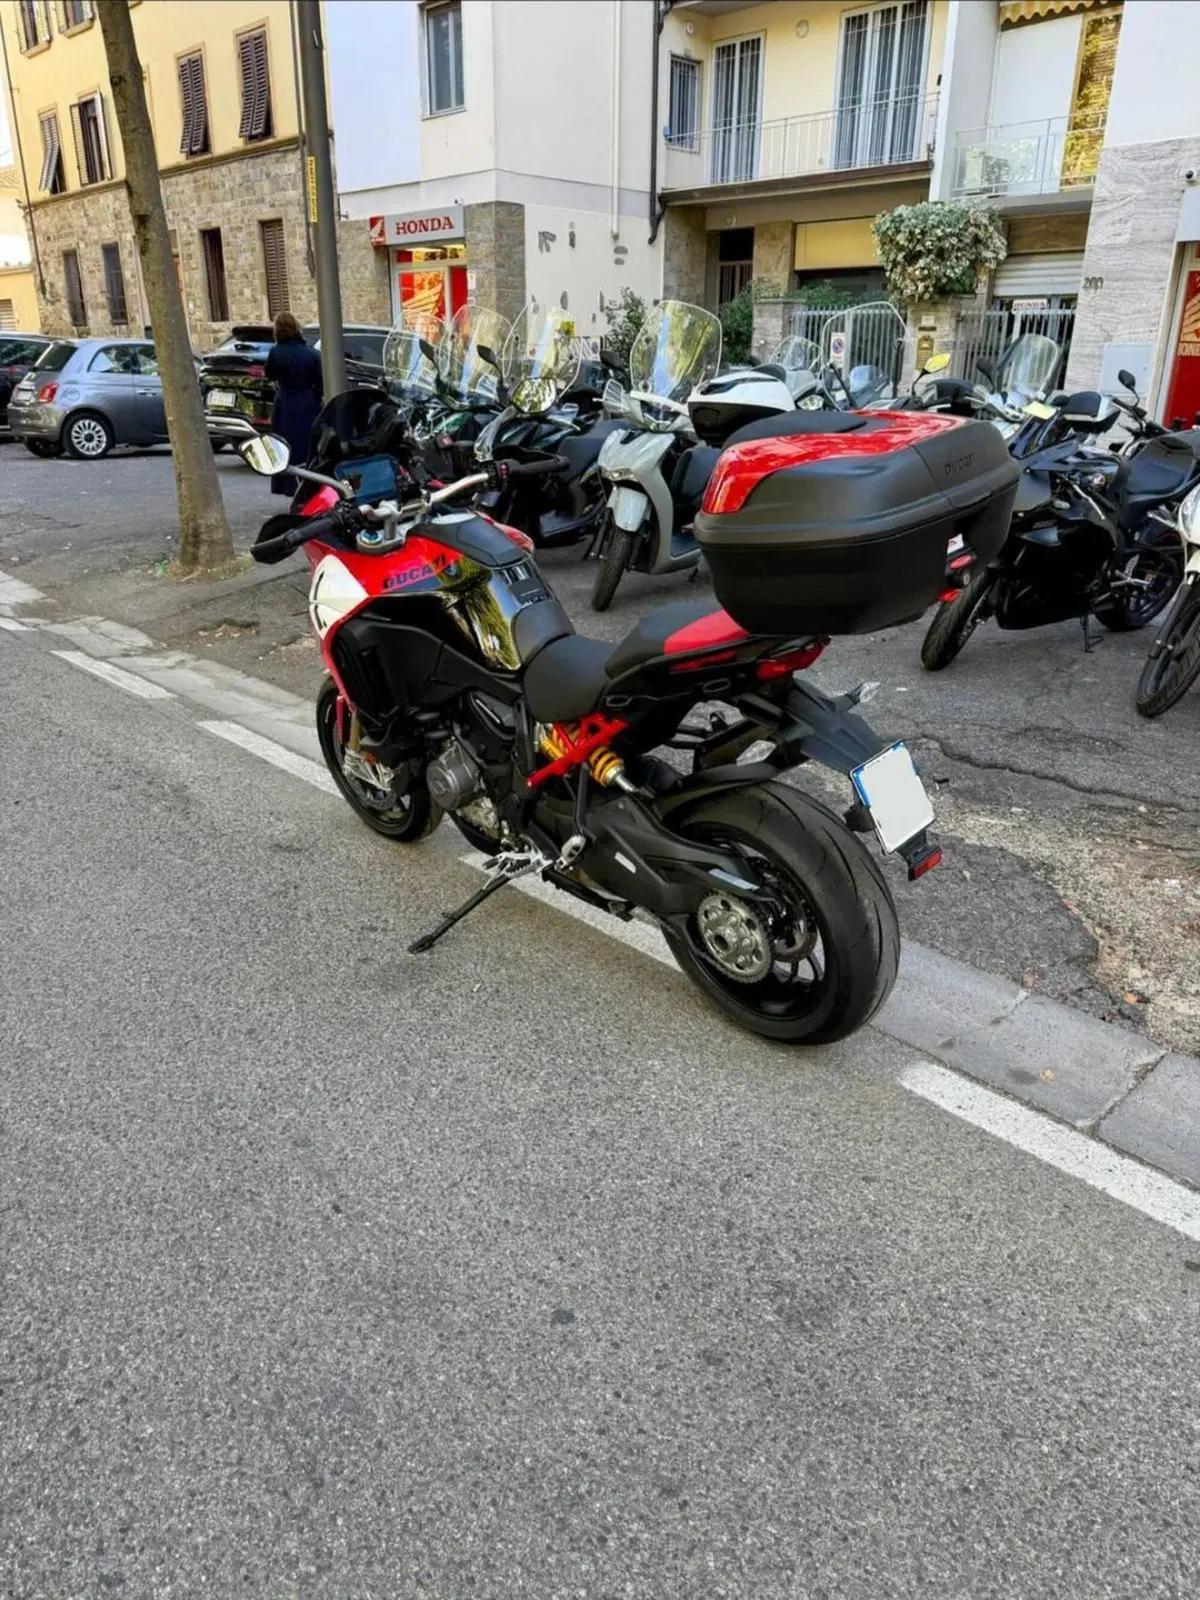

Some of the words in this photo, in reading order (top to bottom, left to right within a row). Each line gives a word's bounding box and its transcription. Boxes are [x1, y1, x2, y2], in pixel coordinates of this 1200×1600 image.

[396, 217, 455, 235] HONDA
[943, 453, 977, 475] DUCATI
[383, 552, 446, 589] DUCATI
